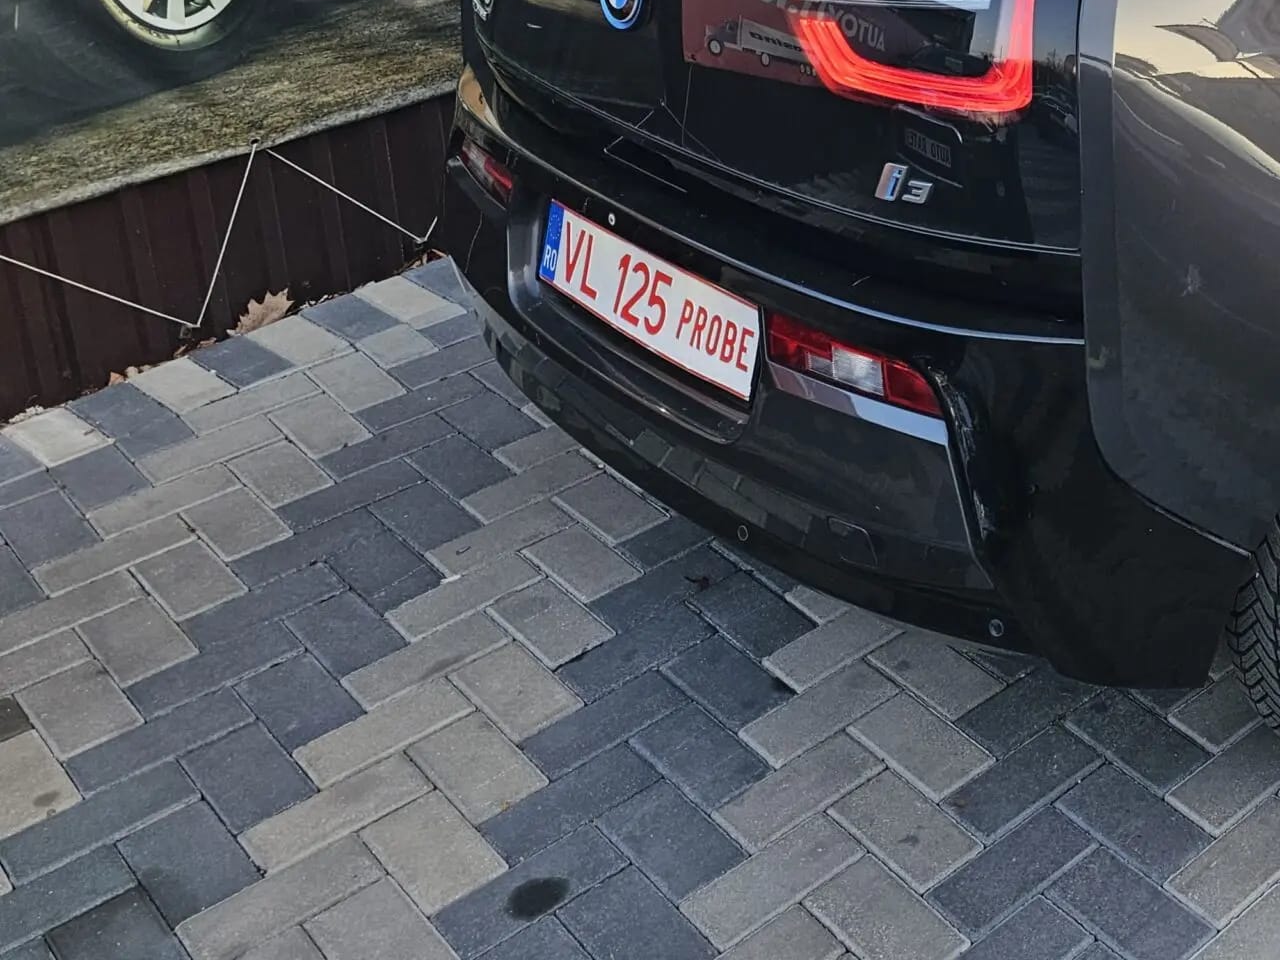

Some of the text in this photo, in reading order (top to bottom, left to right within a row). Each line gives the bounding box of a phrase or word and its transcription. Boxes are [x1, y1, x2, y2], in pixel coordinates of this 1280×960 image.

[875, 162, 933, 204] i3
[543, 220, 755, 373] RO VL 125 PROBE
